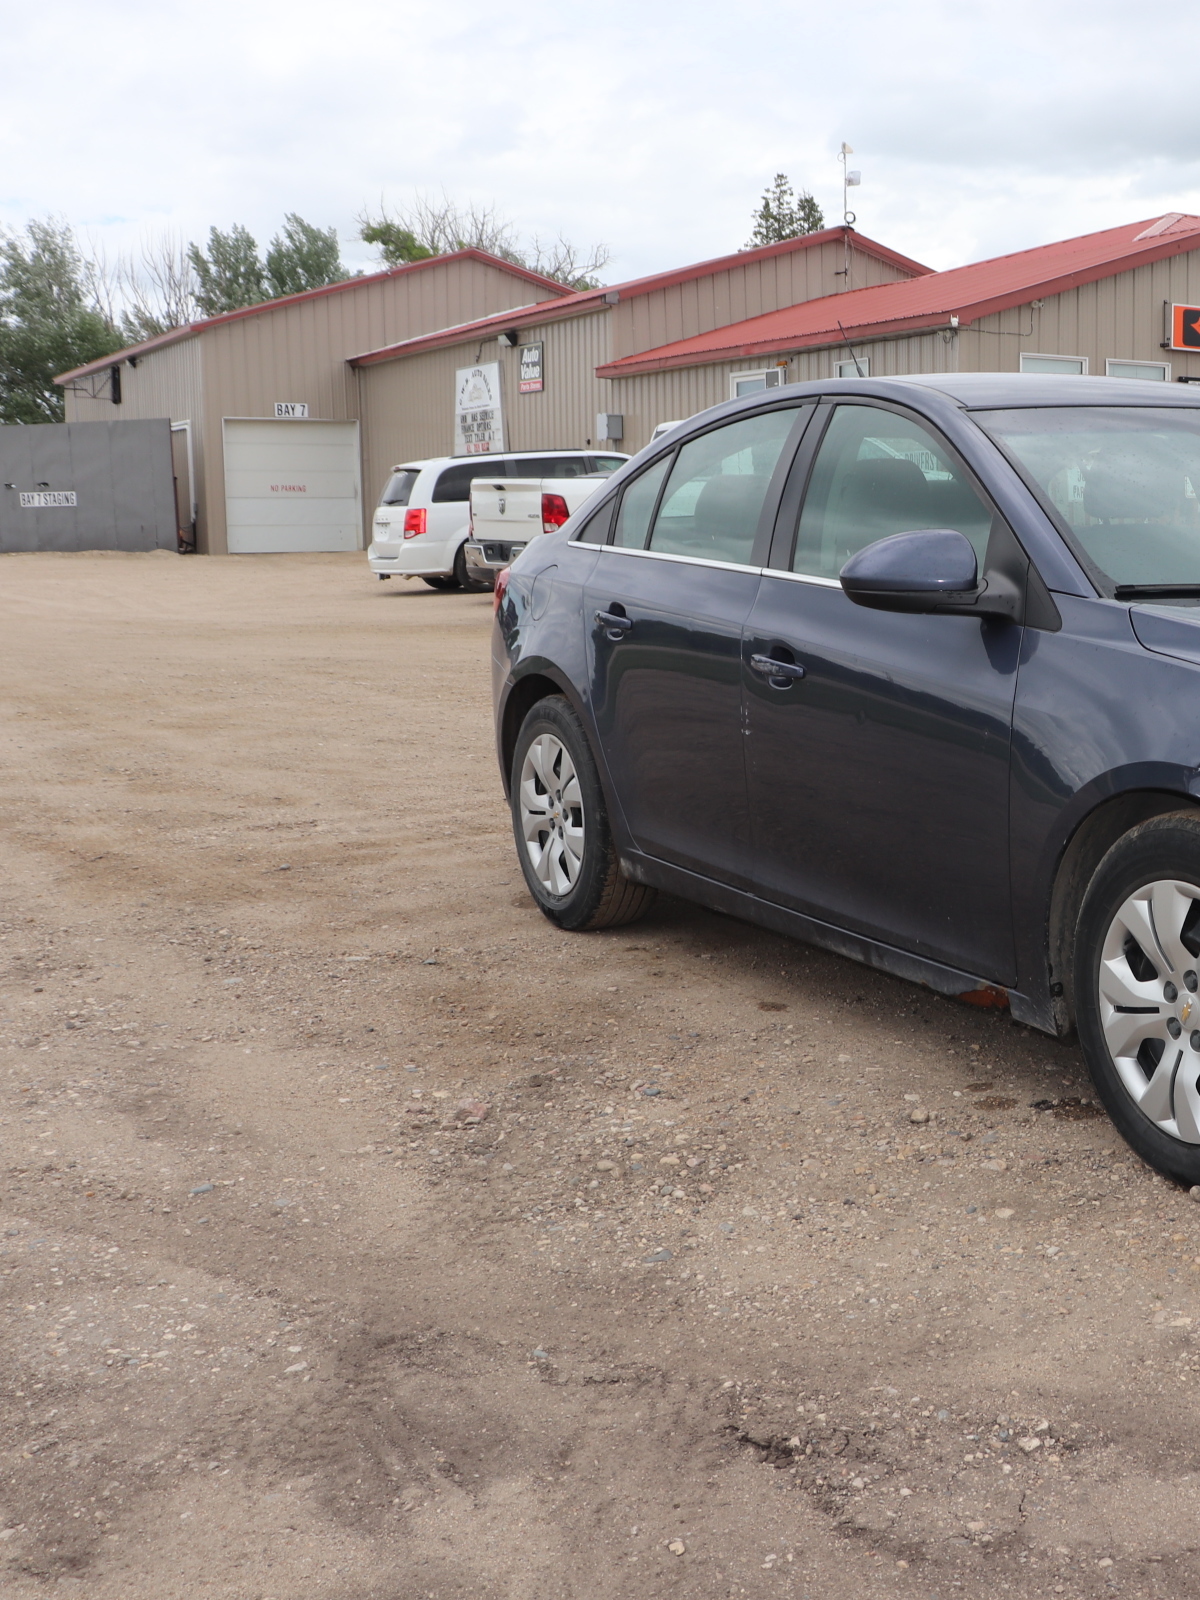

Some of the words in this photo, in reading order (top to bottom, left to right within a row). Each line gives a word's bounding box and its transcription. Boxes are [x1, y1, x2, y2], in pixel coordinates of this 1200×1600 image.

[522, 346, 539, 364] Auto
[472, 369, 483, 378] AUTO
[520, 363, 540, 380] Value
[276, 403, 296, 416] BAY
[300, 404, 306, 416] 7
[281, 485, 307, 493] PARKING
[21, 493, 35, 506] BAY
[37, 493, 41, 506] 7
[43, 492, 75, 506] STAGING
